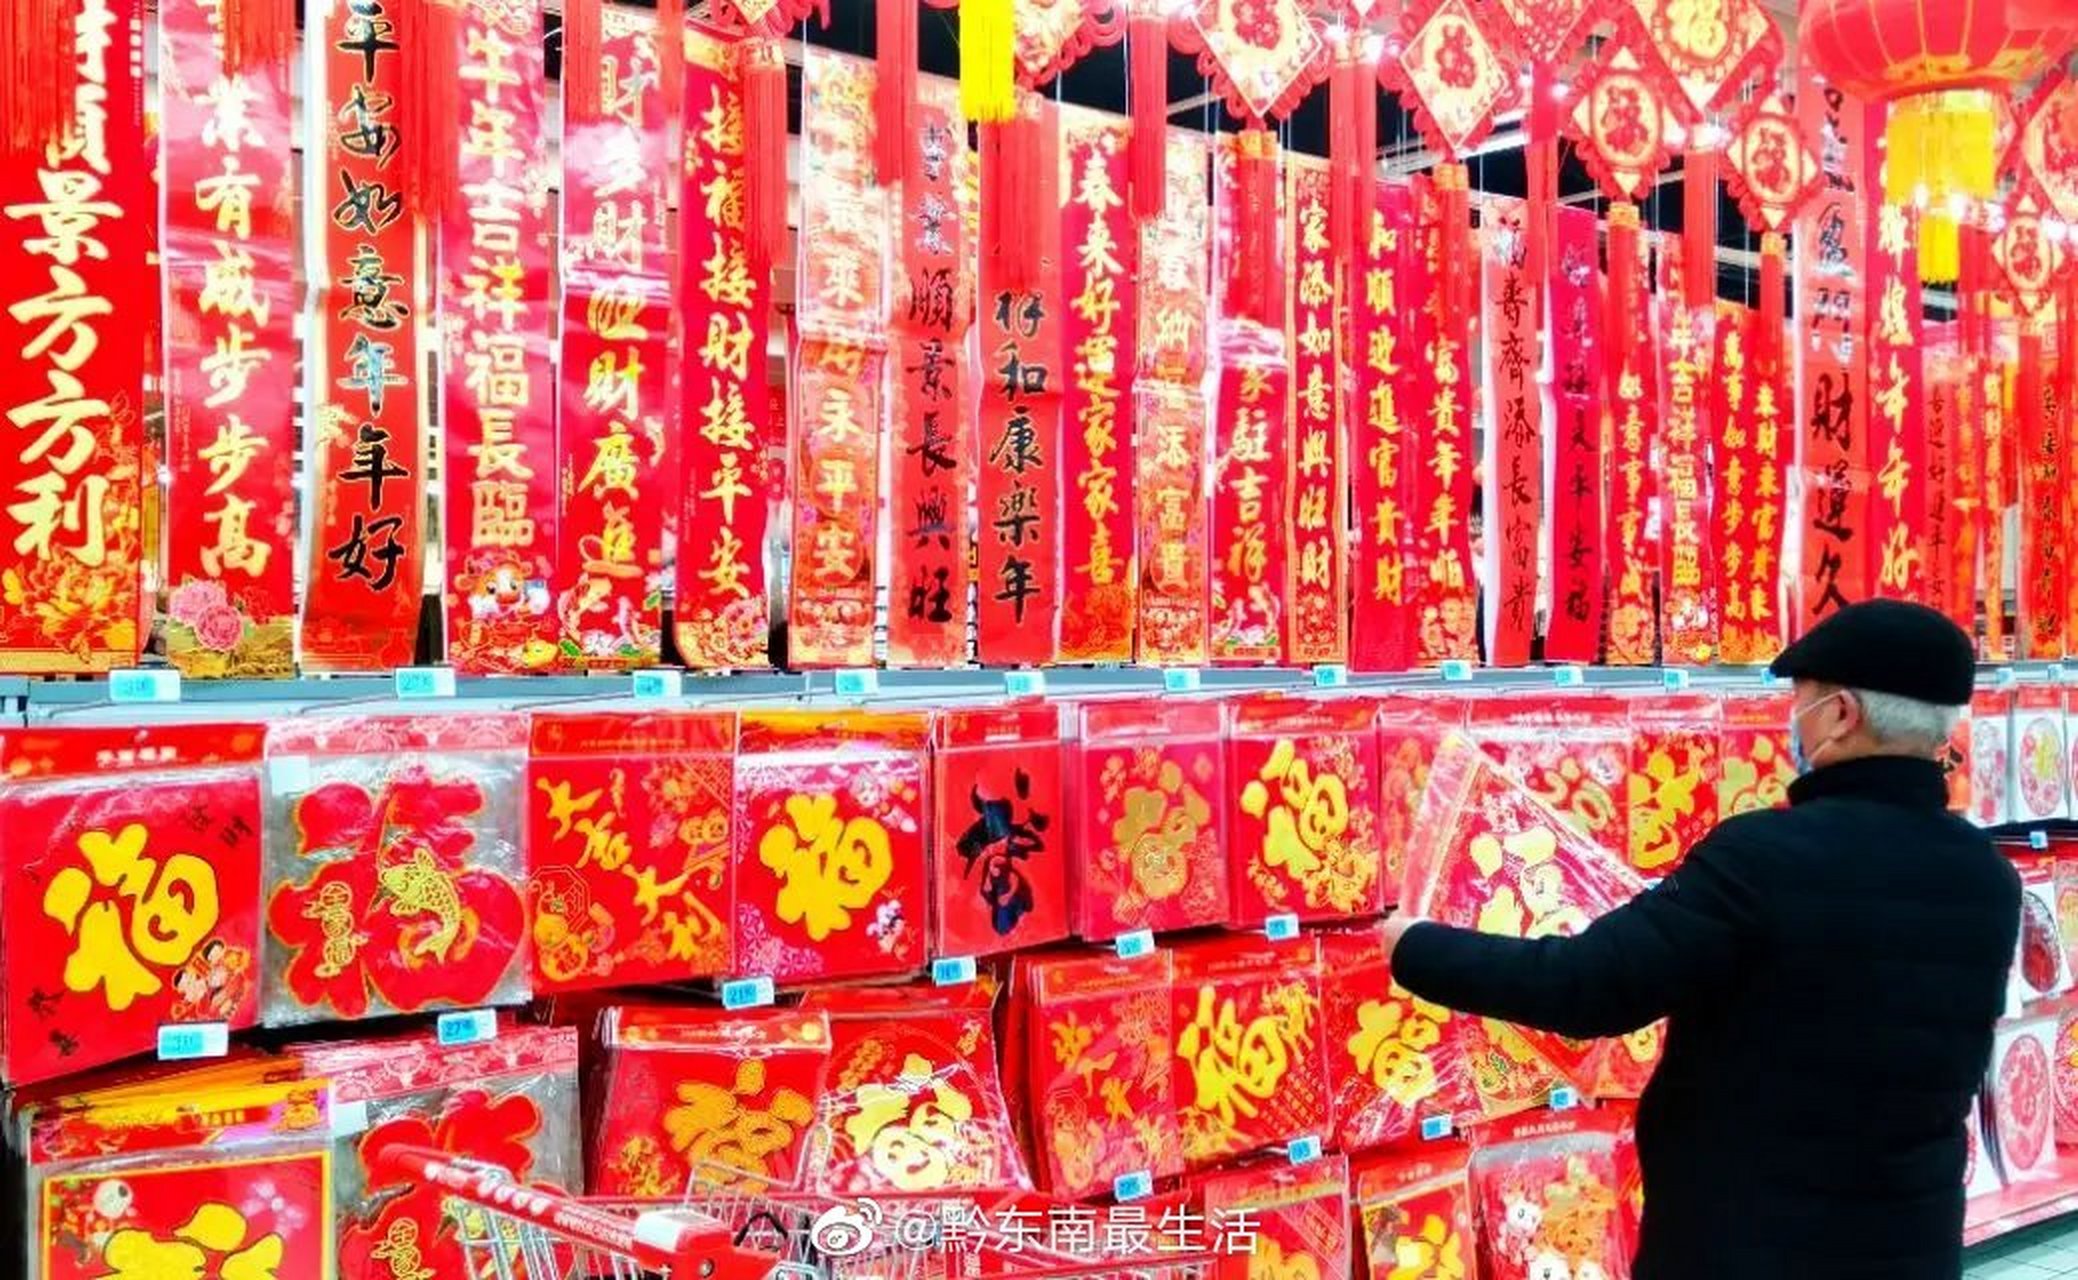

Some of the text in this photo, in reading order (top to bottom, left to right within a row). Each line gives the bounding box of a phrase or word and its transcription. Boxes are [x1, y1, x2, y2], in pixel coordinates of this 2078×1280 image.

[327, 0, 410, 592] 平安如意年年好
[456, 26, 536, 549] 牛年吉祥福長臨
[1666, 266, 1702, 586] 年吉祥福長臨
[44, 823, 219, 1011] 福
[759, 793, 892, 941] 福
